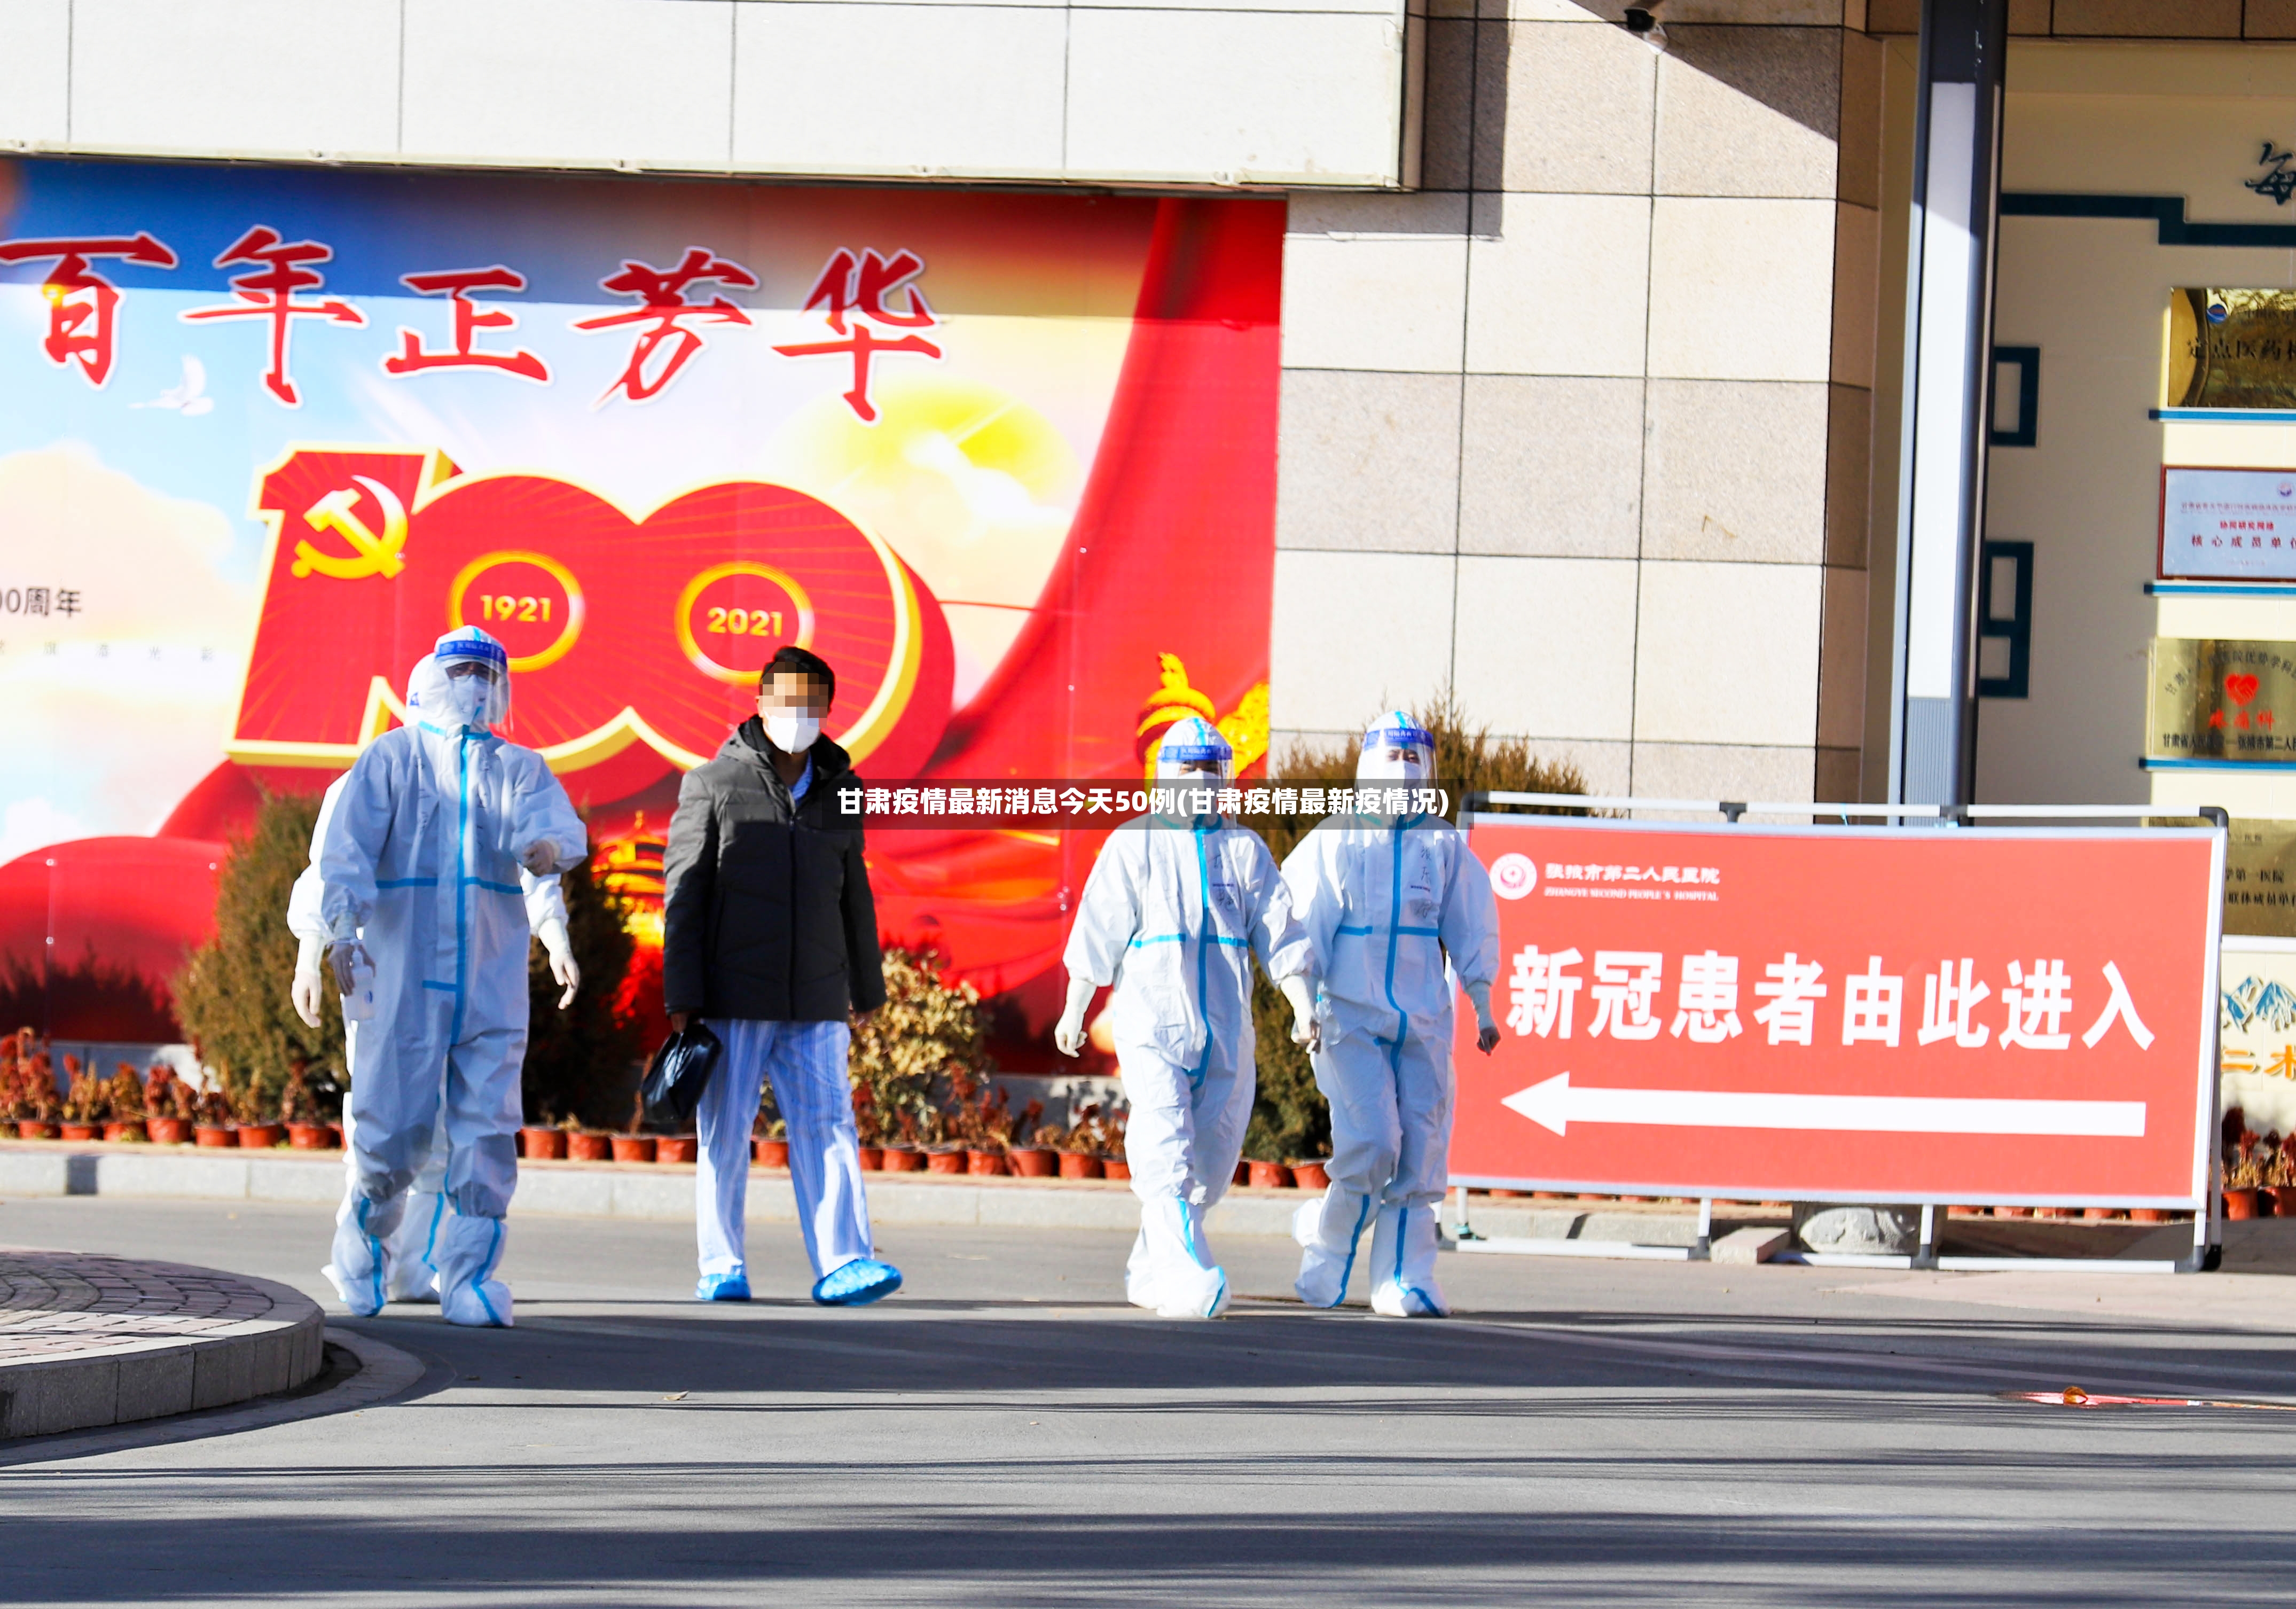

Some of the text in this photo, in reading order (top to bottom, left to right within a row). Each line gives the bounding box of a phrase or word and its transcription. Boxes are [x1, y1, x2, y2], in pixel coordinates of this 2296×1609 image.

[0, 225, 943, 423] 百年正芳华
[0, 587, 82, 618] 0周年
[481, 594, 551, 622] 1921
[707, 607, 782, 637] 2021
[1545, 863, 1720, 885] 张掖市第二人民医院
[1544, 886, 1588, 897] ZHANGYE
[1589, 887, 1627, 899] SECOND
[1673, 891, 1719, 902] HOSPITAL
[2224, 890, 2296, 907] 联体成员单
[1506, 944, 2156, 1051] 新冠患者由此进入
